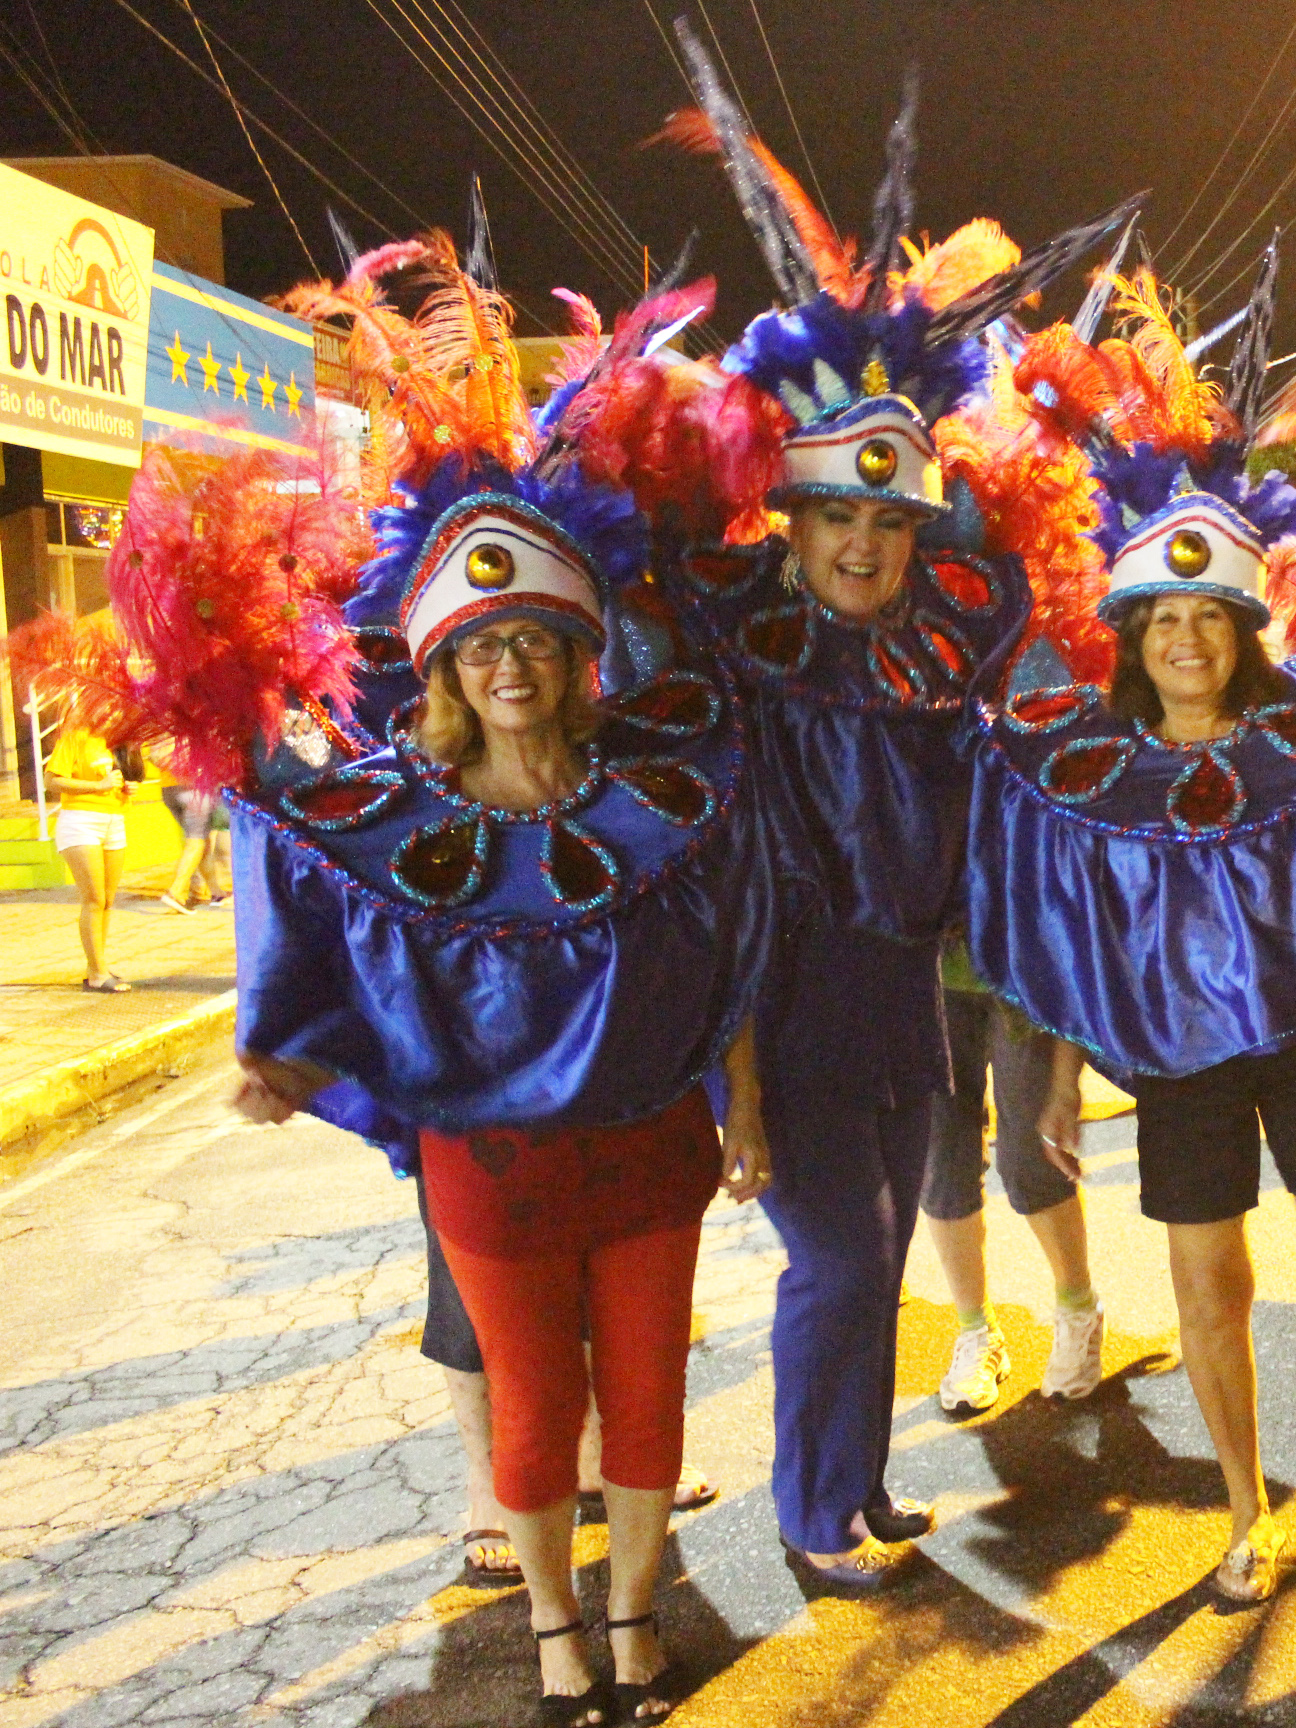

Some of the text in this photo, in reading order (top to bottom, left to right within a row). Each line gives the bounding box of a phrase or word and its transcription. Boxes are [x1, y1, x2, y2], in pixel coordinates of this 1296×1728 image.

[6, 294, 125, 396] DO MAR
[26, 391, 46, 420] de
[50, 395, 135, 440] Condutores
